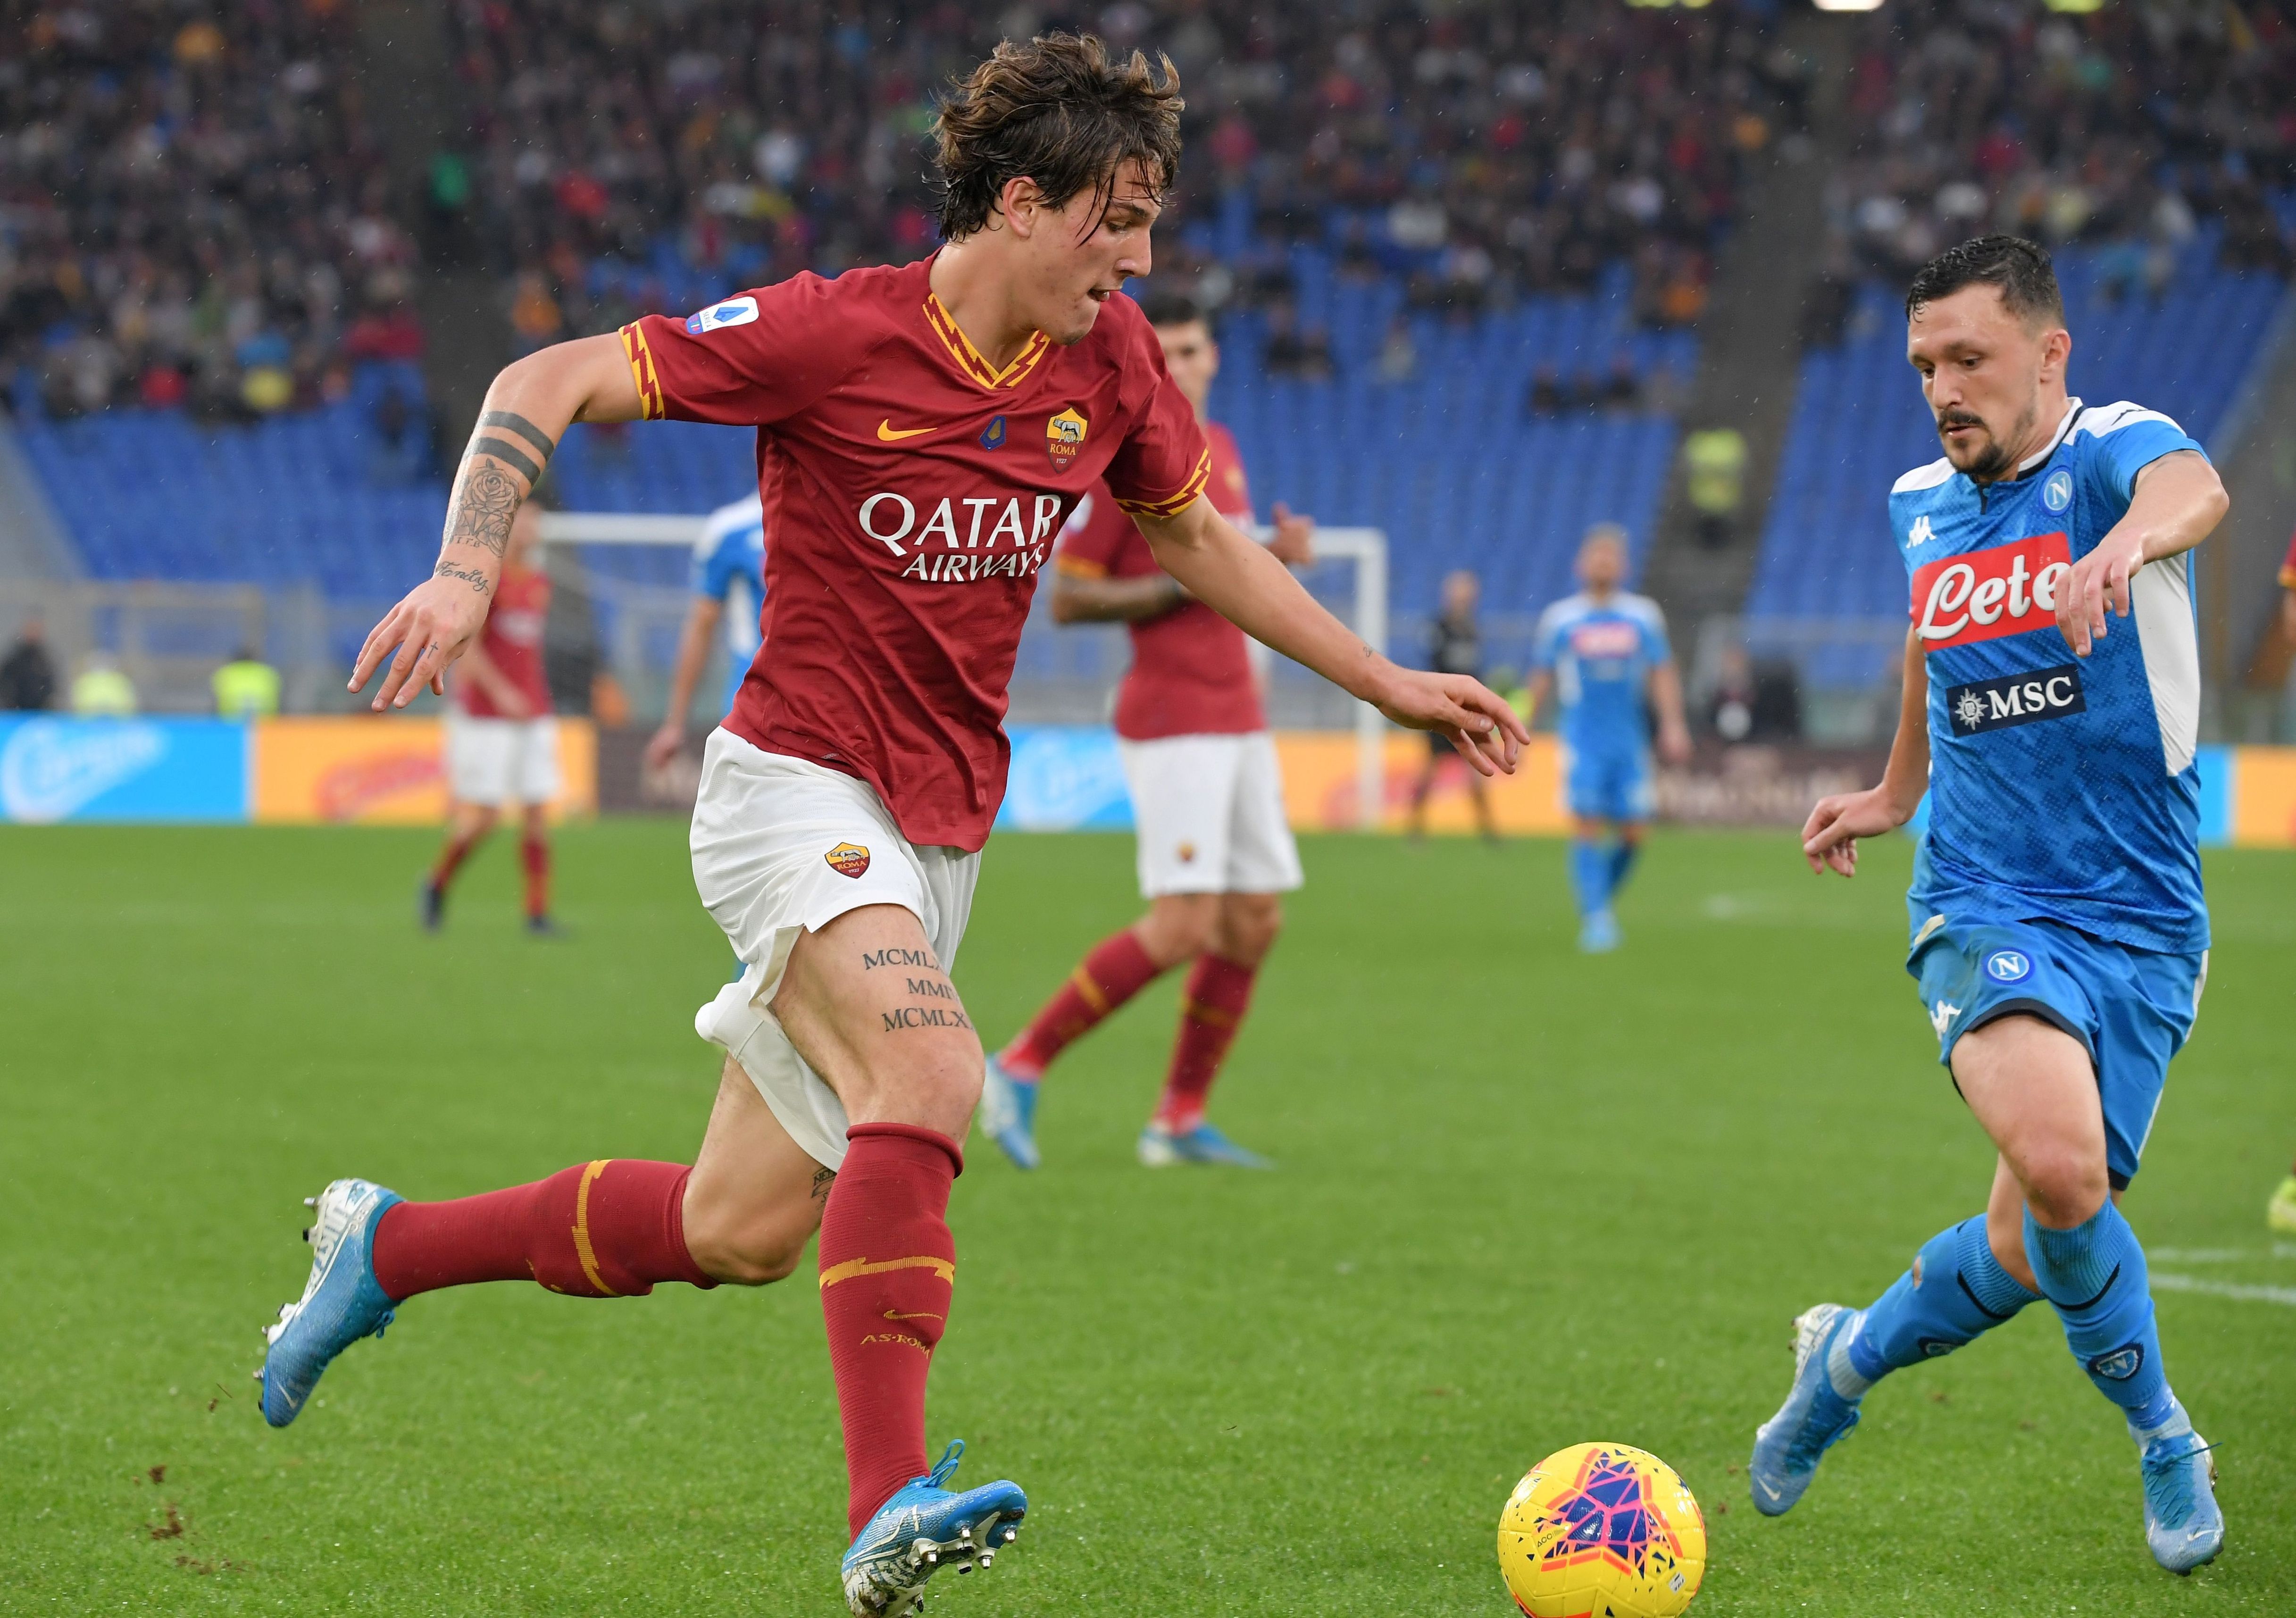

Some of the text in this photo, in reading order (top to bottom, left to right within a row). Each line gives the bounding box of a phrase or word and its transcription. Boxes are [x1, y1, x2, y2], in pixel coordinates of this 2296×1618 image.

[1050, 443, 1076, 456] ROMA
[2050, 476, 2067, 505] N
[858, 492, 1061, 557] QATAR
[901, 542, 1045, 582] AIRWAYS
[1915, 554, 2072, 642] Lete
[1986, 676, 2075, 720] MSC
[837, 860, 867, 870] ROMA
[1995, 956, 2020, 976] N
